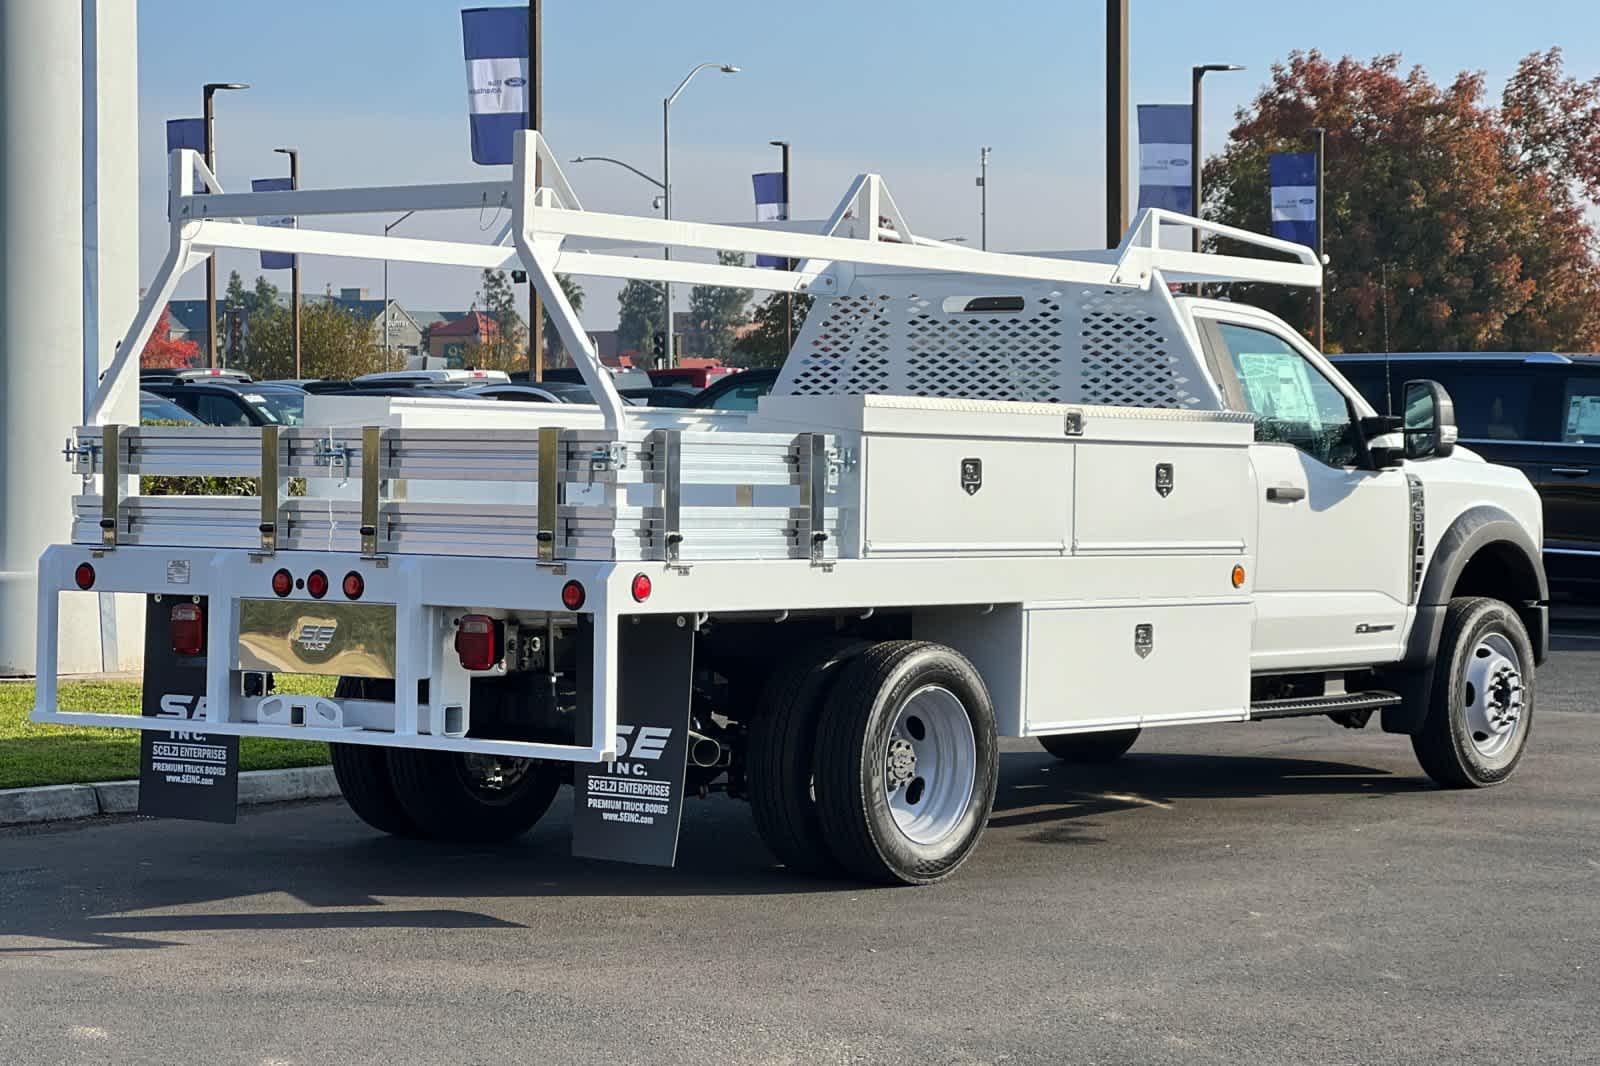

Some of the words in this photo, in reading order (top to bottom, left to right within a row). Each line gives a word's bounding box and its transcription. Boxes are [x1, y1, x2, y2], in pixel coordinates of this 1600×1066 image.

[297, 624, 337, 643] SE
[152, 745, 179, 757] SCELZI
[180, 746, 227, 760] ENTERPRISES
[152, 762, 183, 773] PREMIUM
[184, 764, 206, 774] TRUCK
[205, 766, 226, 776] BODIES
[607, 761, 648, 776] INC.
[166, 774, 214, 785] www.SEINC.com
[587, 779, 617, 793] SCELZI
[618, 783, 670, 797] ENTERPRISES
[587, 798, 622, 810] PREMIUM
[623, 801, 644, 812] TRUCK
[645, 803, 669, 815] BODIES
[602, 812, 654, 825] www.SEINC.com
